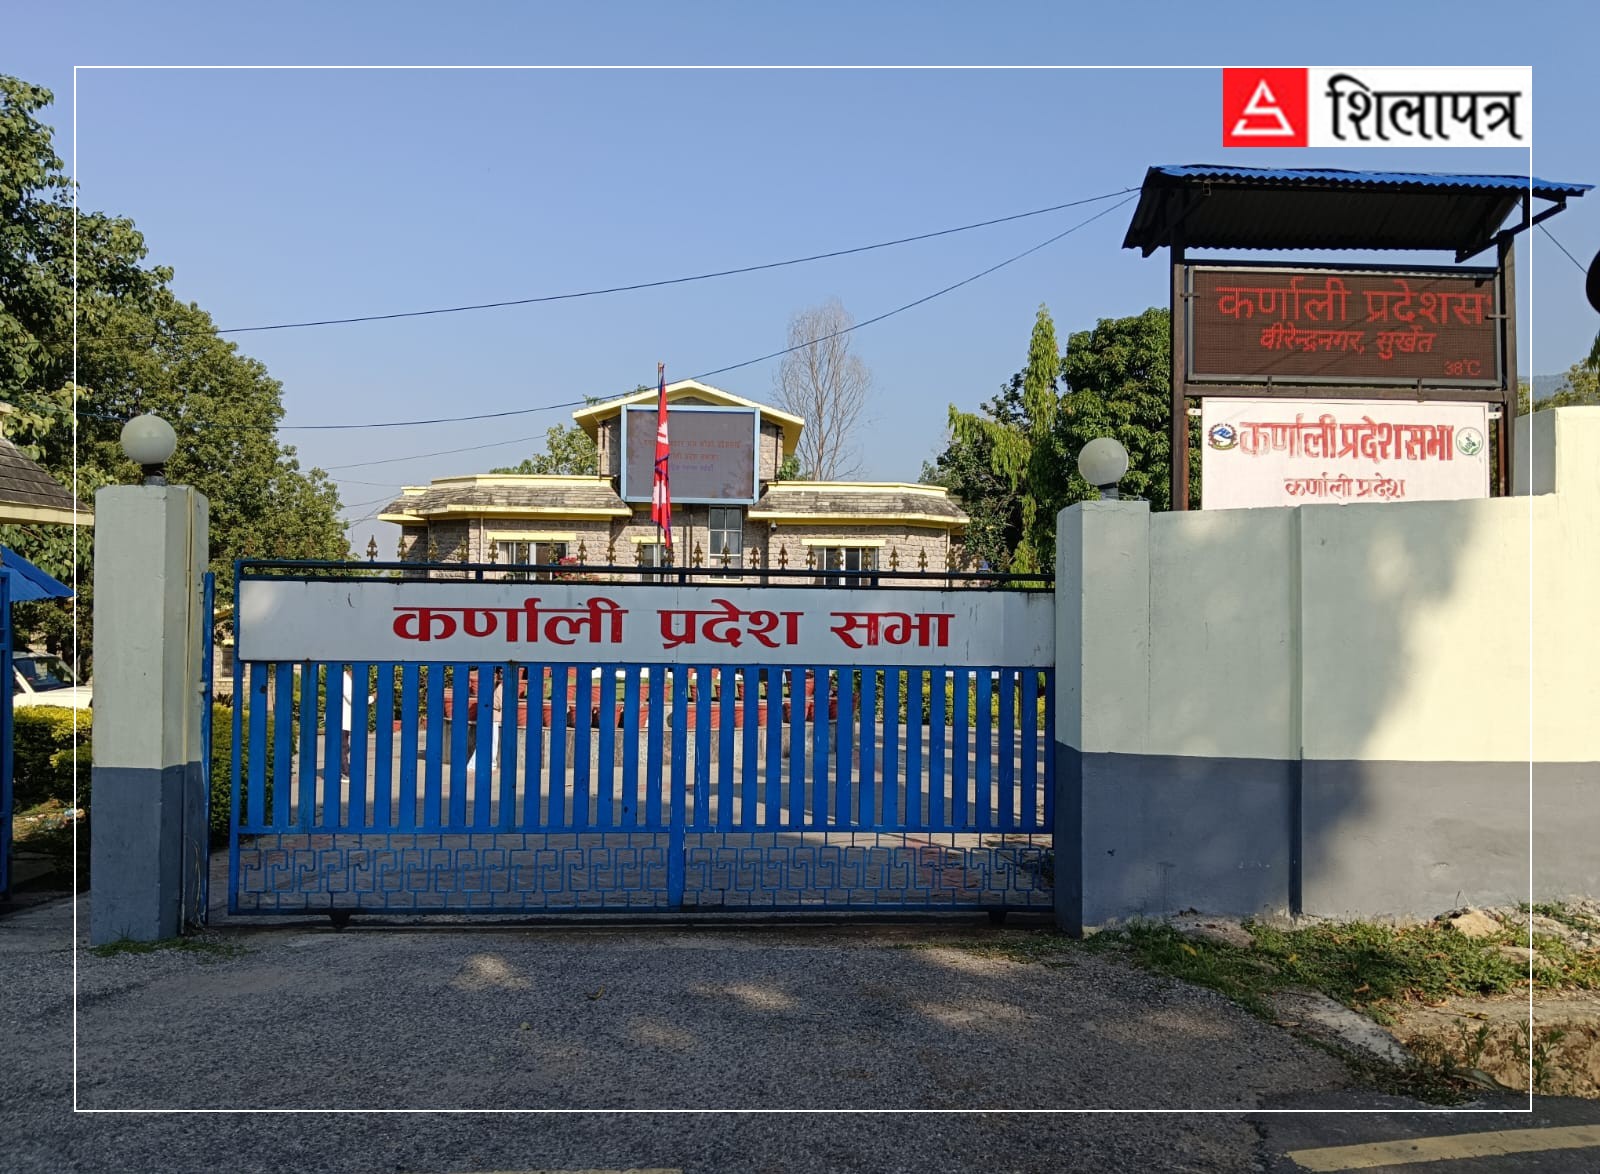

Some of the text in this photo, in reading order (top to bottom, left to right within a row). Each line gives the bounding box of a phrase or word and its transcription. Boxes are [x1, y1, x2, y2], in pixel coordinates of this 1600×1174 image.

[1215, 276, 1351, 321] कर्णाली
[1283, 471, 1406, 500] कर्णाली प्रदेश
[393, 598, 955, 649] कर्णाली प्रदेश सभा
